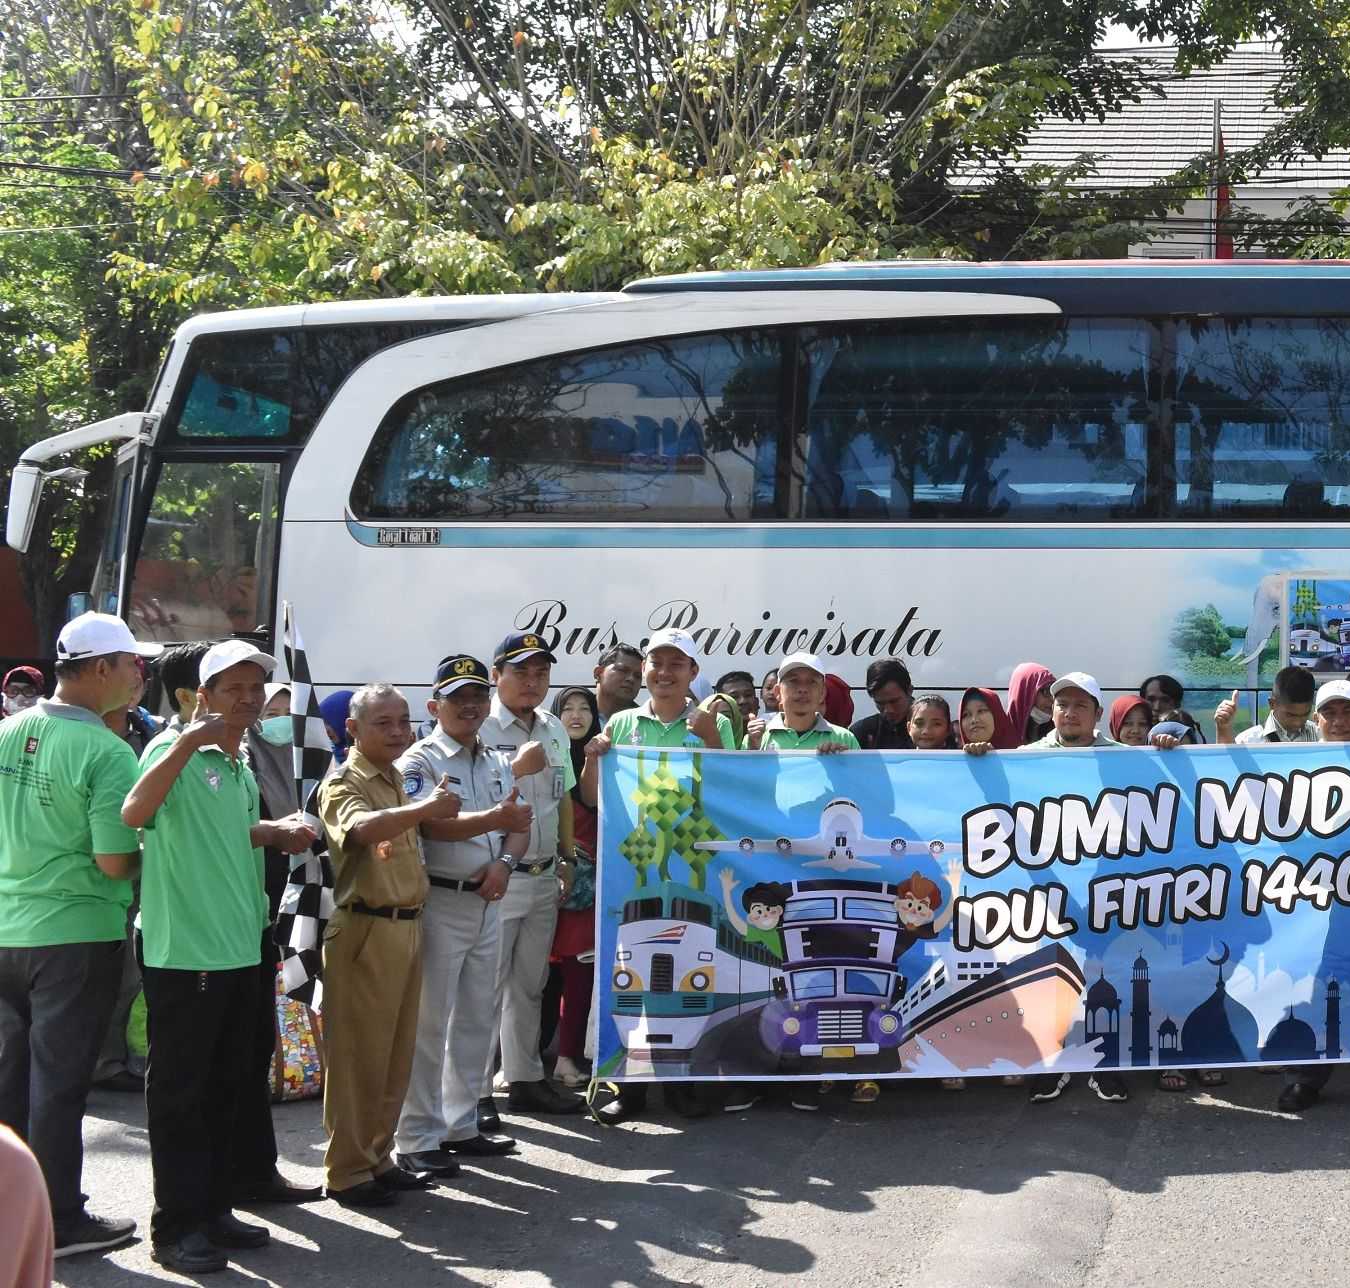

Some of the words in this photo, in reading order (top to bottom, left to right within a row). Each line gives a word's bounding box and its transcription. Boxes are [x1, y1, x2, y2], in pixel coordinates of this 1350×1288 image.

[514, 600, 618, 656] Bus
[640, 600, 943, 657] Pariwisata
[962, 782, 1181, 878] BUMN
[953, 882, 1077, 951] IDUL
[1088, 863, 1231, 933] FITRI
